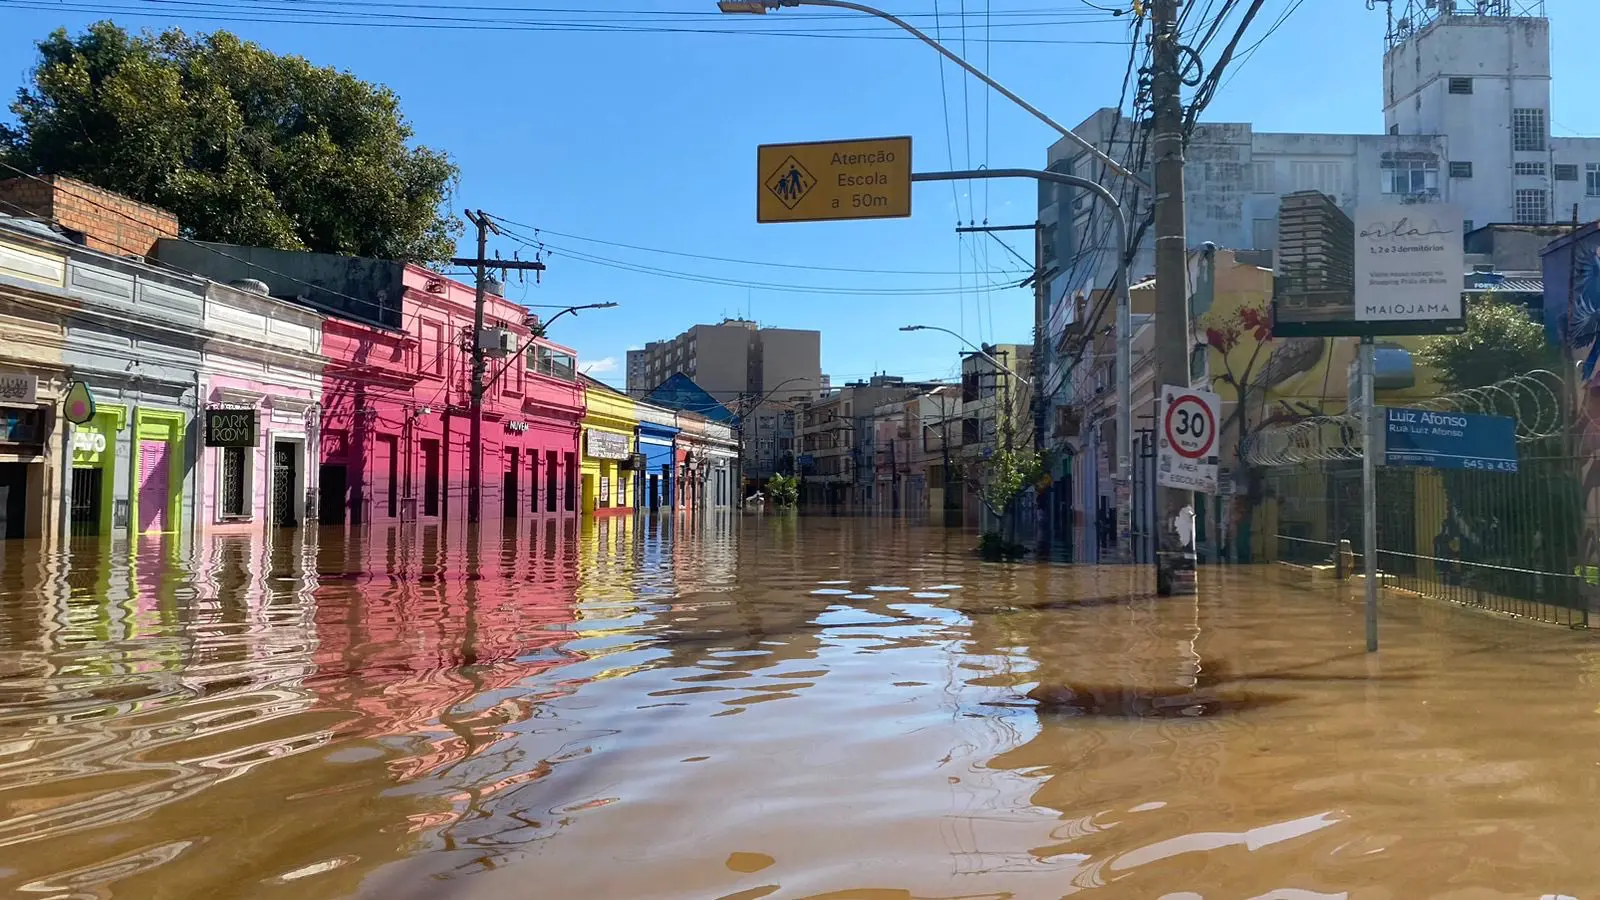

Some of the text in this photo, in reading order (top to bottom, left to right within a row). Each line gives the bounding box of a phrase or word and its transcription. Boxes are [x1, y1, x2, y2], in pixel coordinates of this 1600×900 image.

[830, 150, 895, 166] Atenção
[838, 172, 888, 187] Escola
[831, 193, 888, 208] a 50m
[1366, 304, 1449, 314] MAIOJAMA
[212, 414, 249, 428] DARK
[1176, 409, 1205, 438] 30
[1389, 409, 1468, 427] Luiz Afonso
[212, 427, 249, 441] ROOM
[1389, 424, 1464, 437] Rua Luiz Afonso
[1463, 458, 1519, 472] 645 a 435
